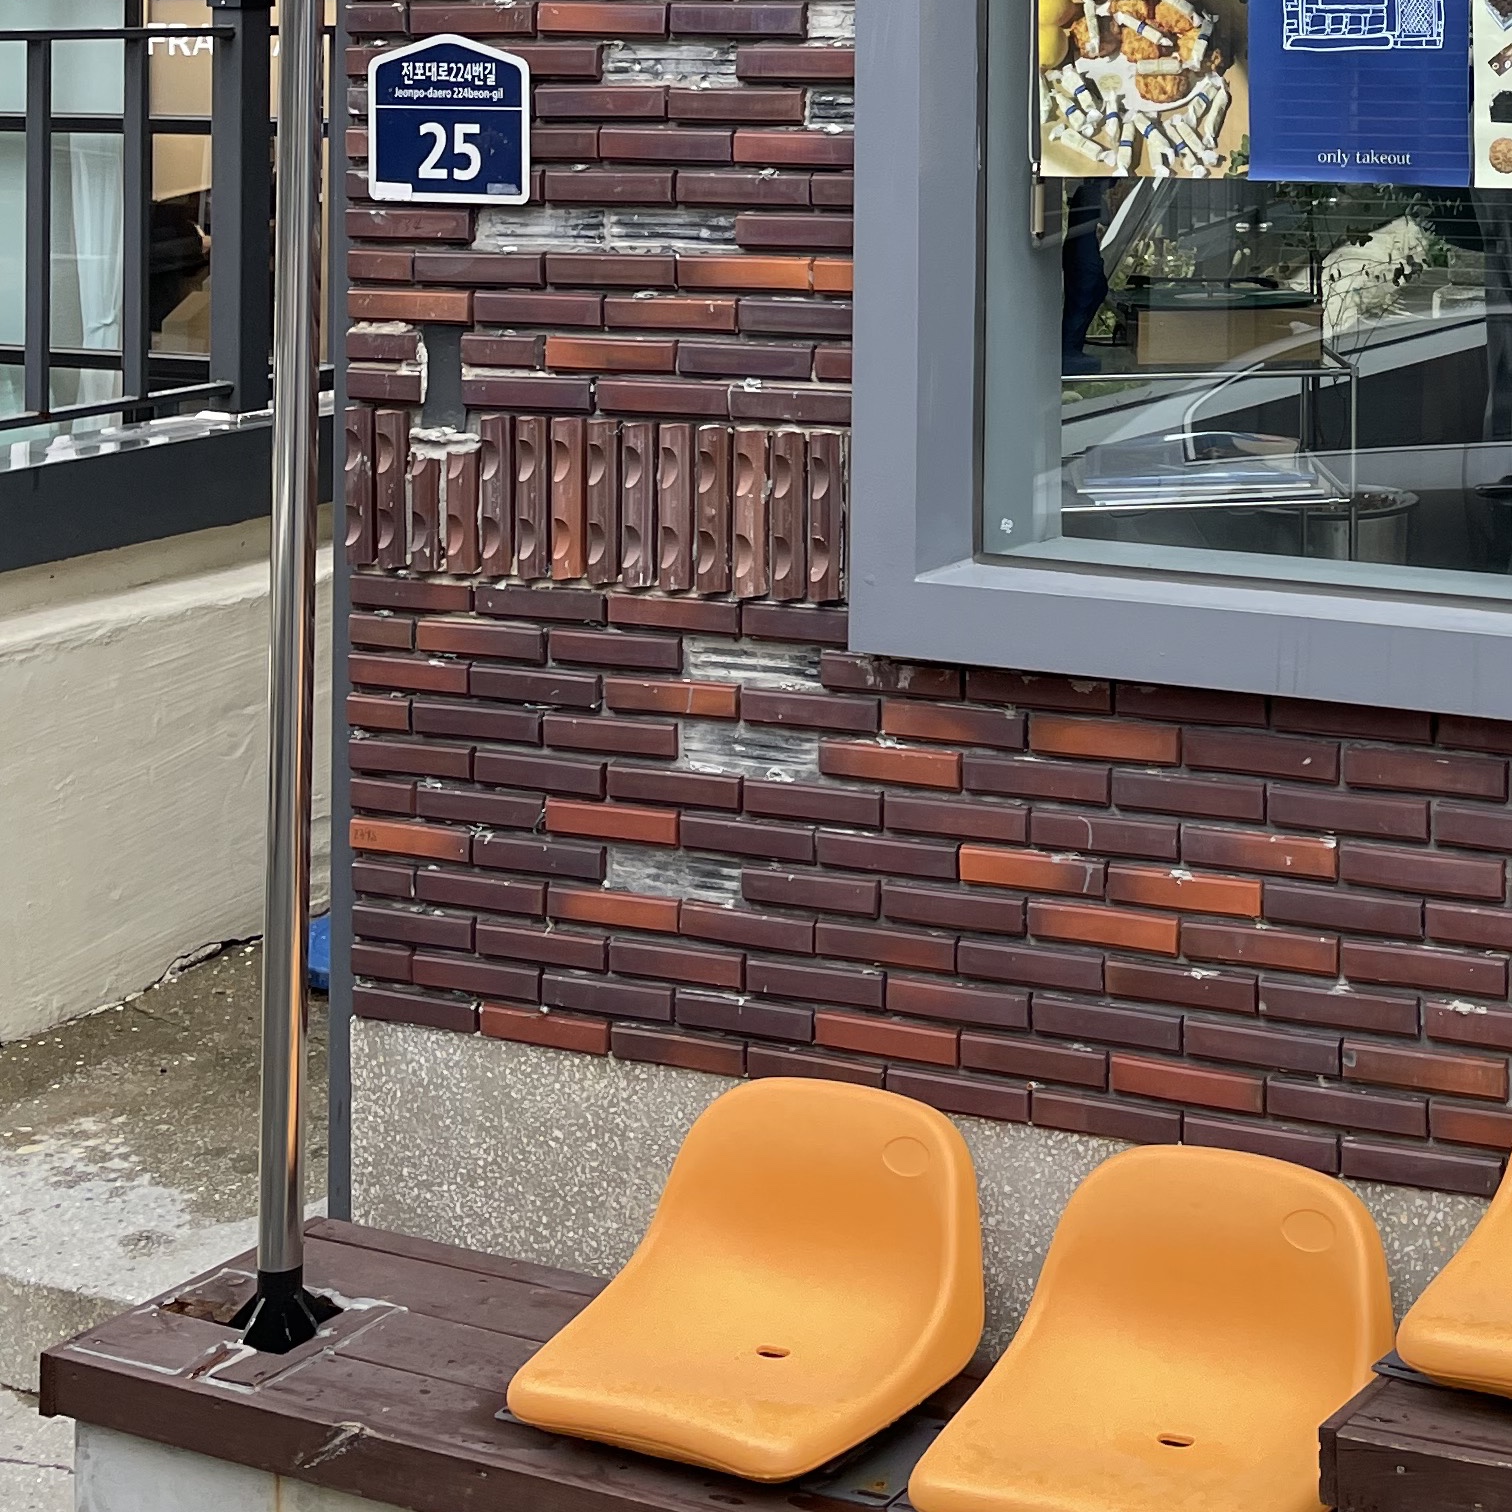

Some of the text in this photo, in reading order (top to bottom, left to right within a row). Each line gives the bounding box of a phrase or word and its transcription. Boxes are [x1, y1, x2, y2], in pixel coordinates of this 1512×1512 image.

[402, 62, 496, 86] 전포대로224번길
[394, 86, 504, 101] Jeonpo-daero 224beon-gil
[418, 122, 482, 181] 25
[1317, 149, 1412, 167] only takeout
